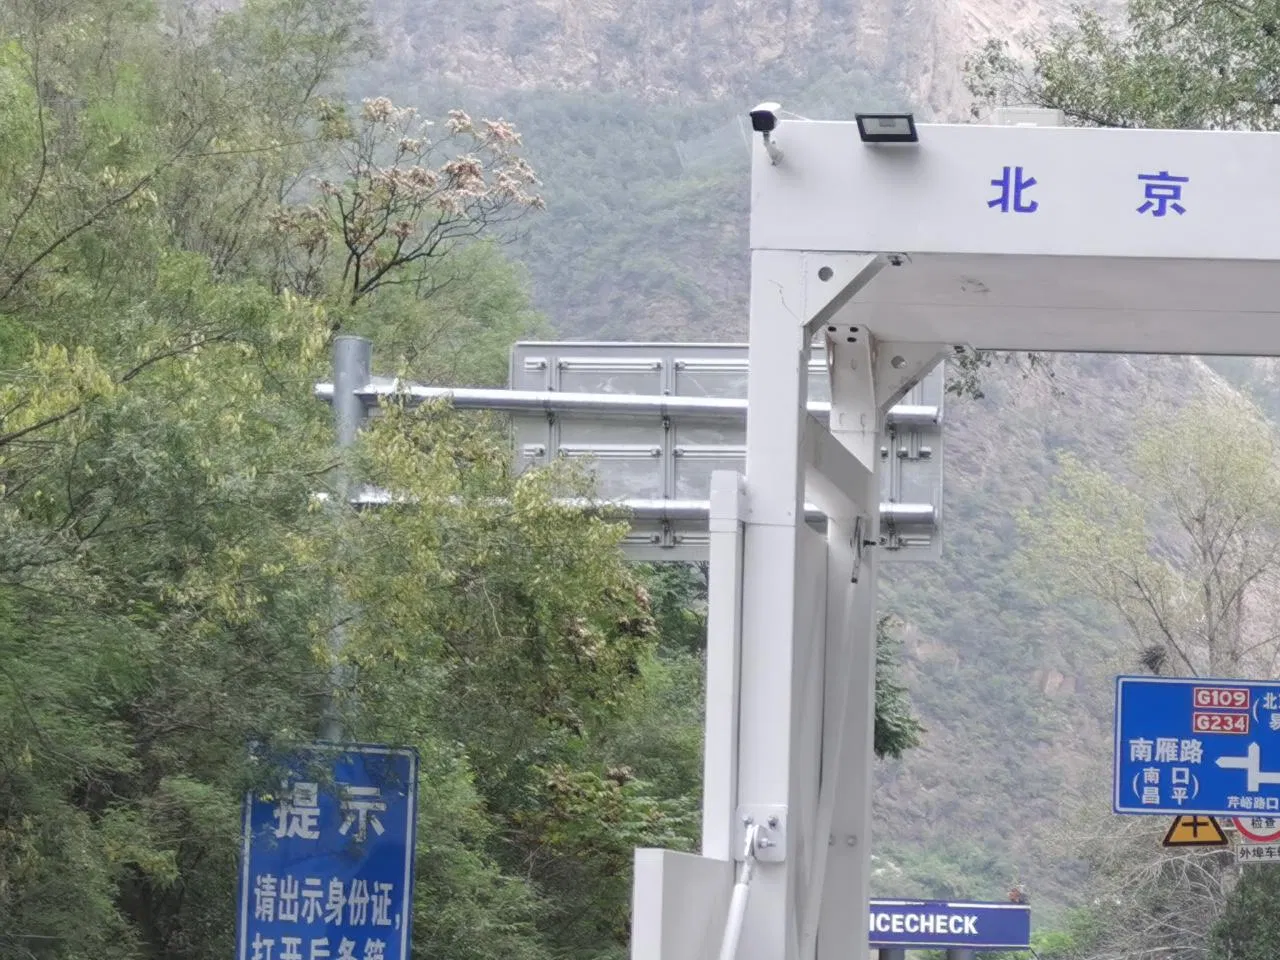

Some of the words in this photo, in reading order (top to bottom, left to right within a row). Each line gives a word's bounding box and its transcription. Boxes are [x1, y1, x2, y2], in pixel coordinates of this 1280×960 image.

[1197, 690, 1247, 706] G109
[1196, 714, 1246, 731] G234
[1129, 738, 1203, 764] 南雁路
[1143, 766, 1190, 785] 南口
[1142, 786, 1190, 805] 昌平
[273, 782, 386, 842] 提示
